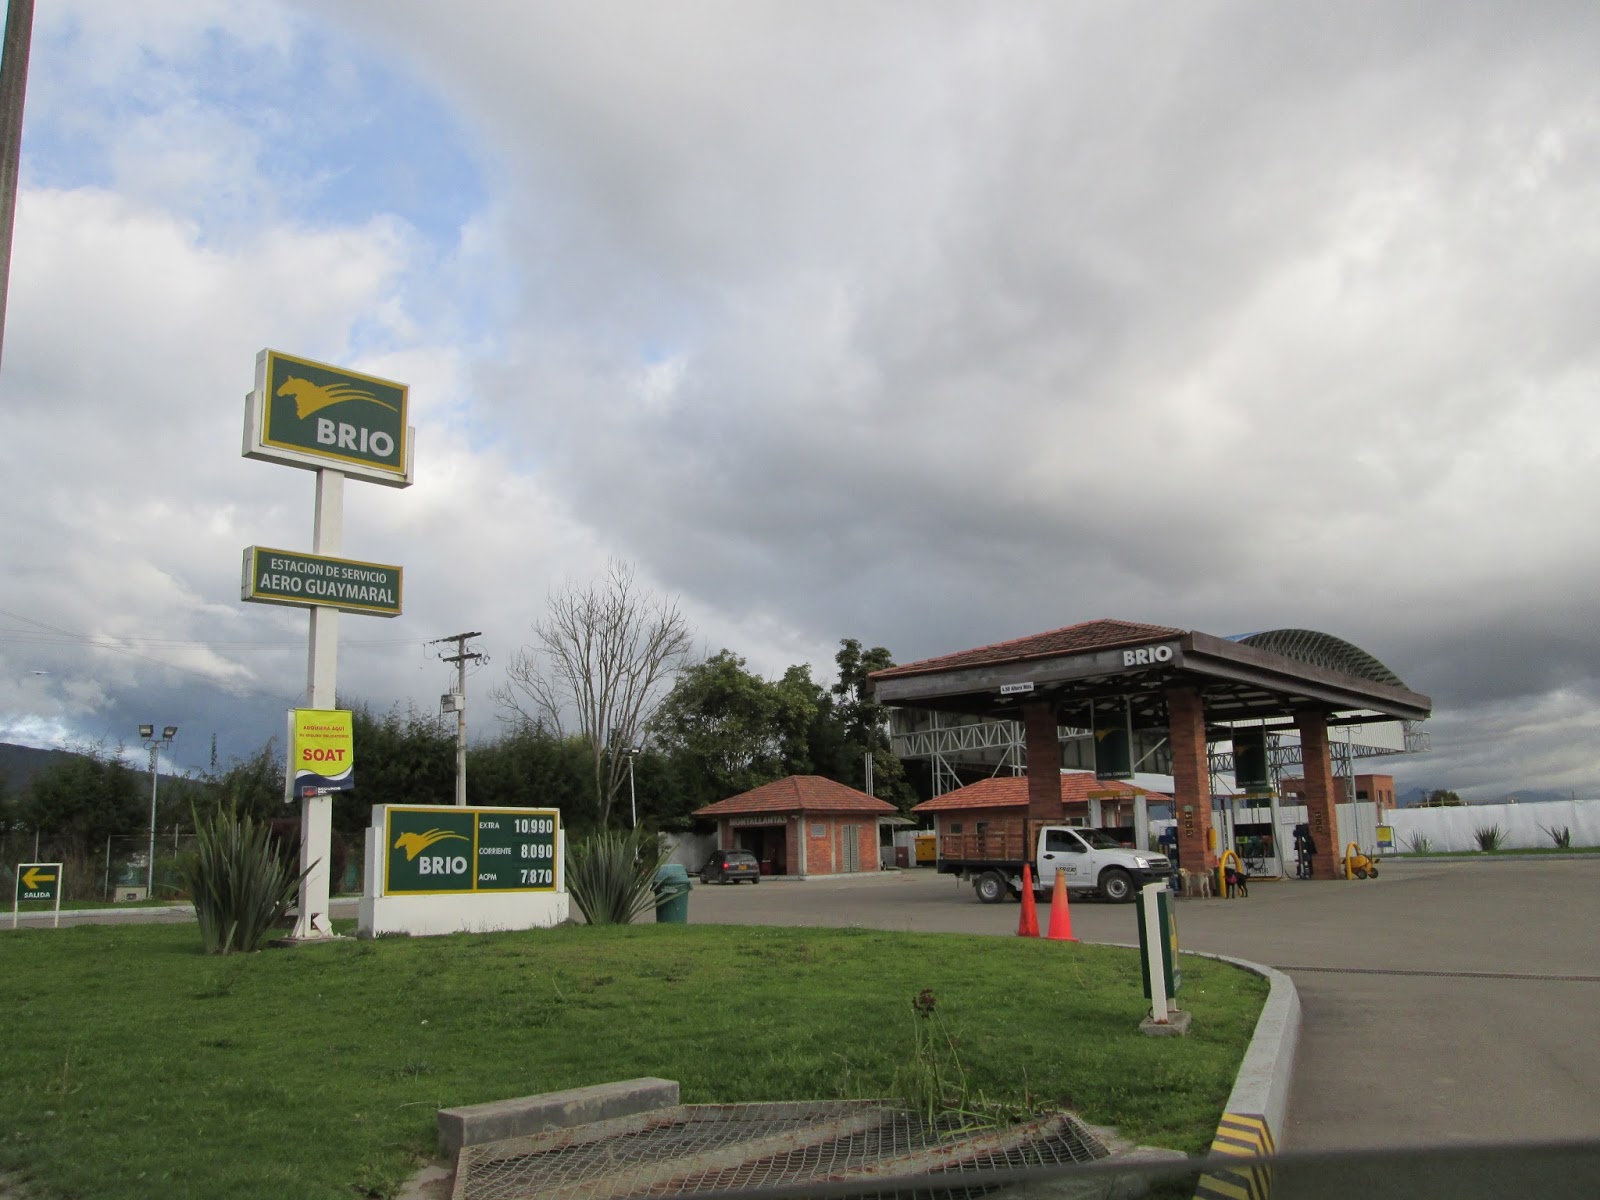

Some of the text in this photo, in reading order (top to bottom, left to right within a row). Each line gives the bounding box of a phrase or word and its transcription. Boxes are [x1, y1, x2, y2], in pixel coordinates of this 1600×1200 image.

[316, 417, 395, 457] BRIO
[271, 558, 387, 584] ESTACION DE SERVICIO
[260, 573, 395, 604] AERO GUAYMARAL
[1123, 645, 1173, 667] BRIO
[303, 748, 345, 762] SOAT
[729, 815, 788, 826] MONTALLANTAS
[478, 847, 512, 855] CORRIENTE
[419, 856, 468, 875] BRIO
[478, 873, 498, 881] ACPM
[24, 891, 51, 899] SALIDA
